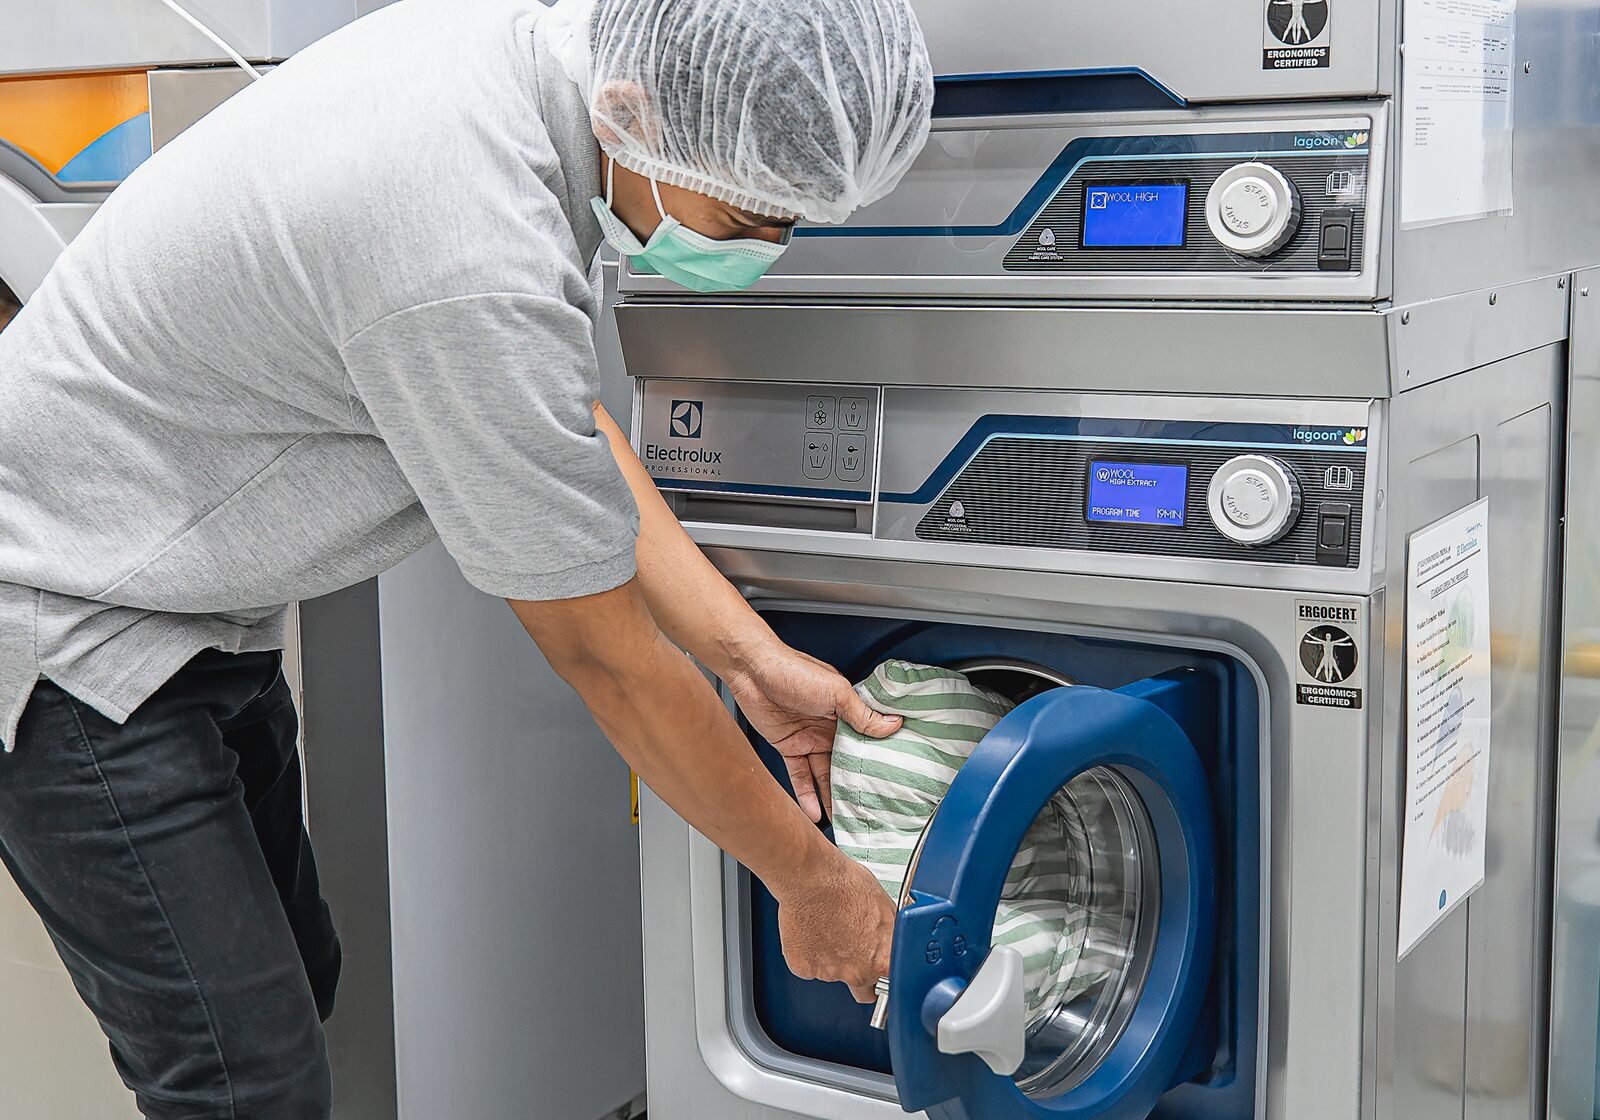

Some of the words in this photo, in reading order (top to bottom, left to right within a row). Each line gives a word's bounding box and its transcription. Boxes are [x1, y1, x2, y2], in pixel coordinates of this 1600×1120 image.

[1267, 48, 1326, 58] ERGONOMICS
[1274, 58, 1318, 67] CERTIFIED
[1106, 192, 1132, 202] WOOL
[1135, 192, 1159, 202] HIGH
[1244, 184, 1269, 208] START
[1225, 205, 1250, 230] START
[646, 444, 722, 463] Electrolux
[1110, 468, 1135, 479] WOOL
[1126, 479, 1157, 487] EXTRACT
[1246, 476, 1270, 502] START
[1092, 506, 1122, 517] PROGRAM
[1125, 508, 1140, 518] TIME
[1226, 495, 1250, 521] START
[1299, 605, 1357, 620] ERGOCERT
[1301, 687, 1357, 698] ERGONOMICS
[1307, 696, 1350, 706] CERTIFIED
